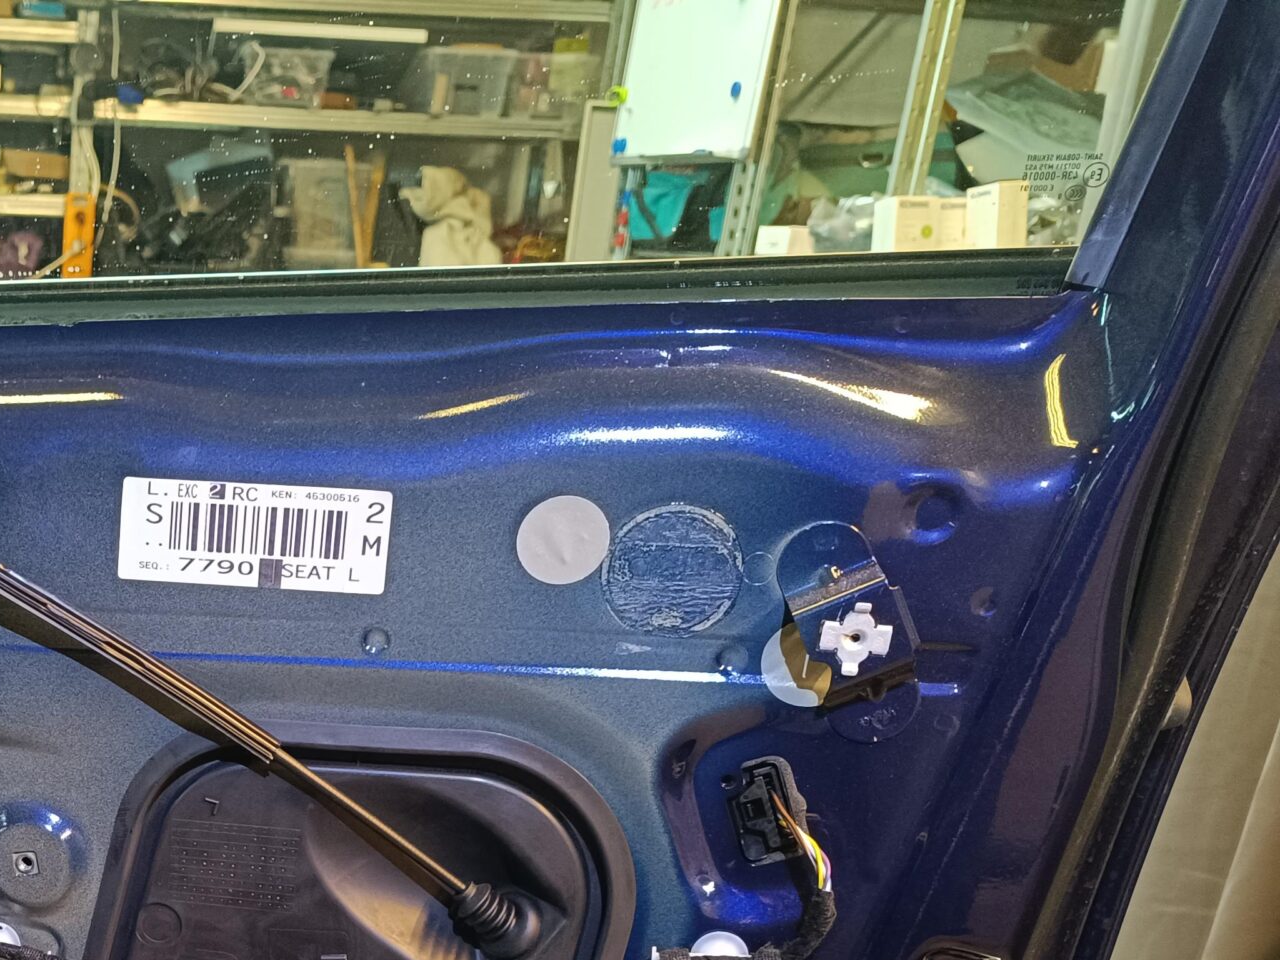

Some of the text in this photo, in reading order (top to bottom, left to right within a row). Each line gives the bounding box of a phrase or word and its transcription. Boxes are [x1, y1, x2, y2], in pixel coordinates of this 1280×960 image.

[177, 483, 199, 499] EXC
[232, 486, 259, 502] RC
[145, 502, 164, 524] S
[365, 502, 385, 524] 2
[361, 535, 382, 557] M
[177, 557, 254, 576] 7790
[281, 563, 336, 581] SEAT
[348, 567, 360, 582] L
